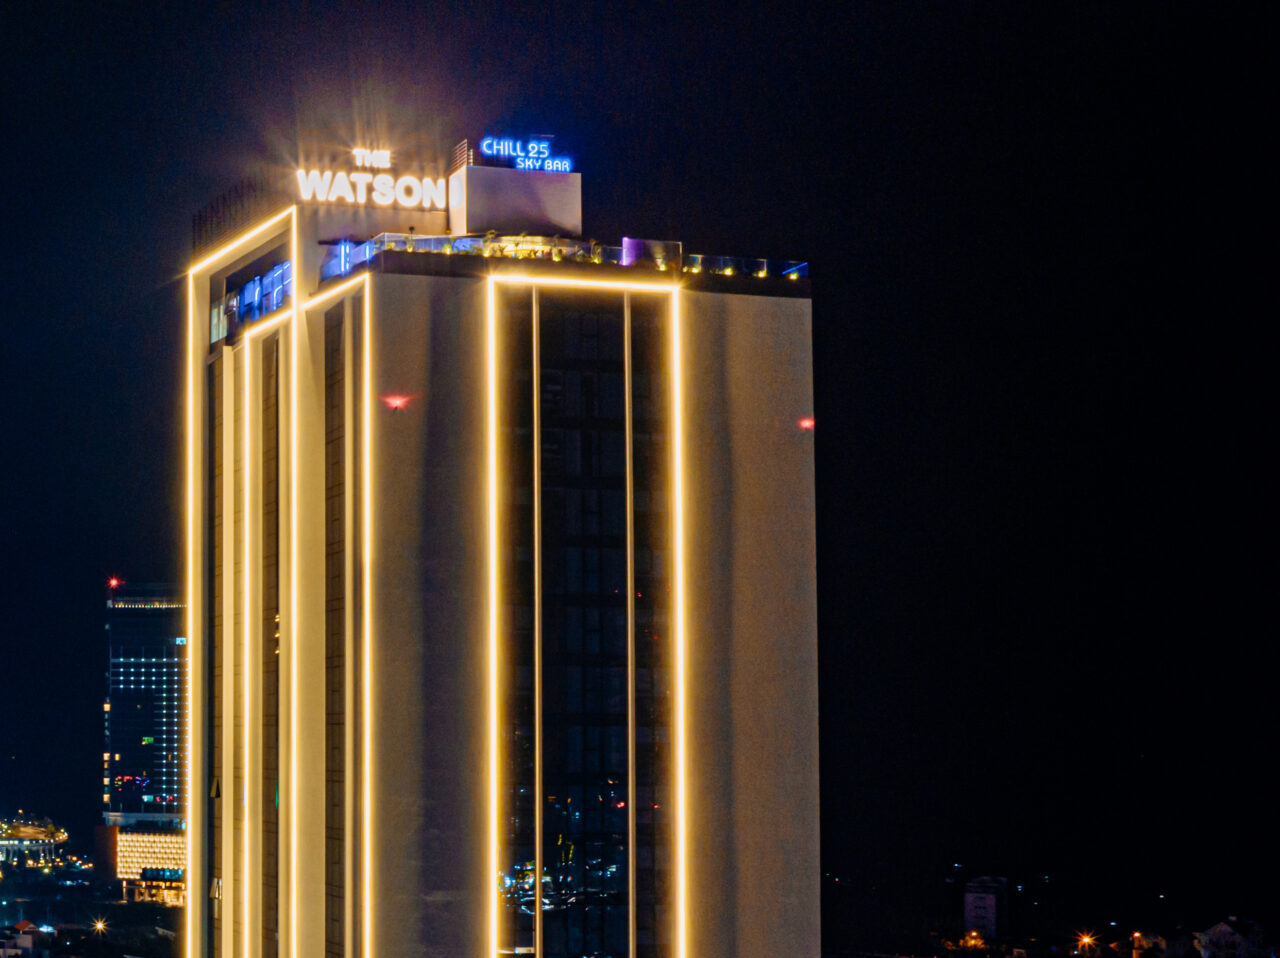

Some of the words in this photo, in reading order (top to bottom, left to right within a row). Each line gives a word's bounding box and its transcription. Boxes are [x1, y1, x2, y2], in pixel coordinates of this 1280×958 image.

[353, 148, 391, 168] THE
[482, 139, 526, 157] CHILL
[528, 143, 549, 158] 25
[516, 157, 542, 169] SKY
[544, 160, 571, 172] BAR
[296, 169, 447, 209] WATSON
